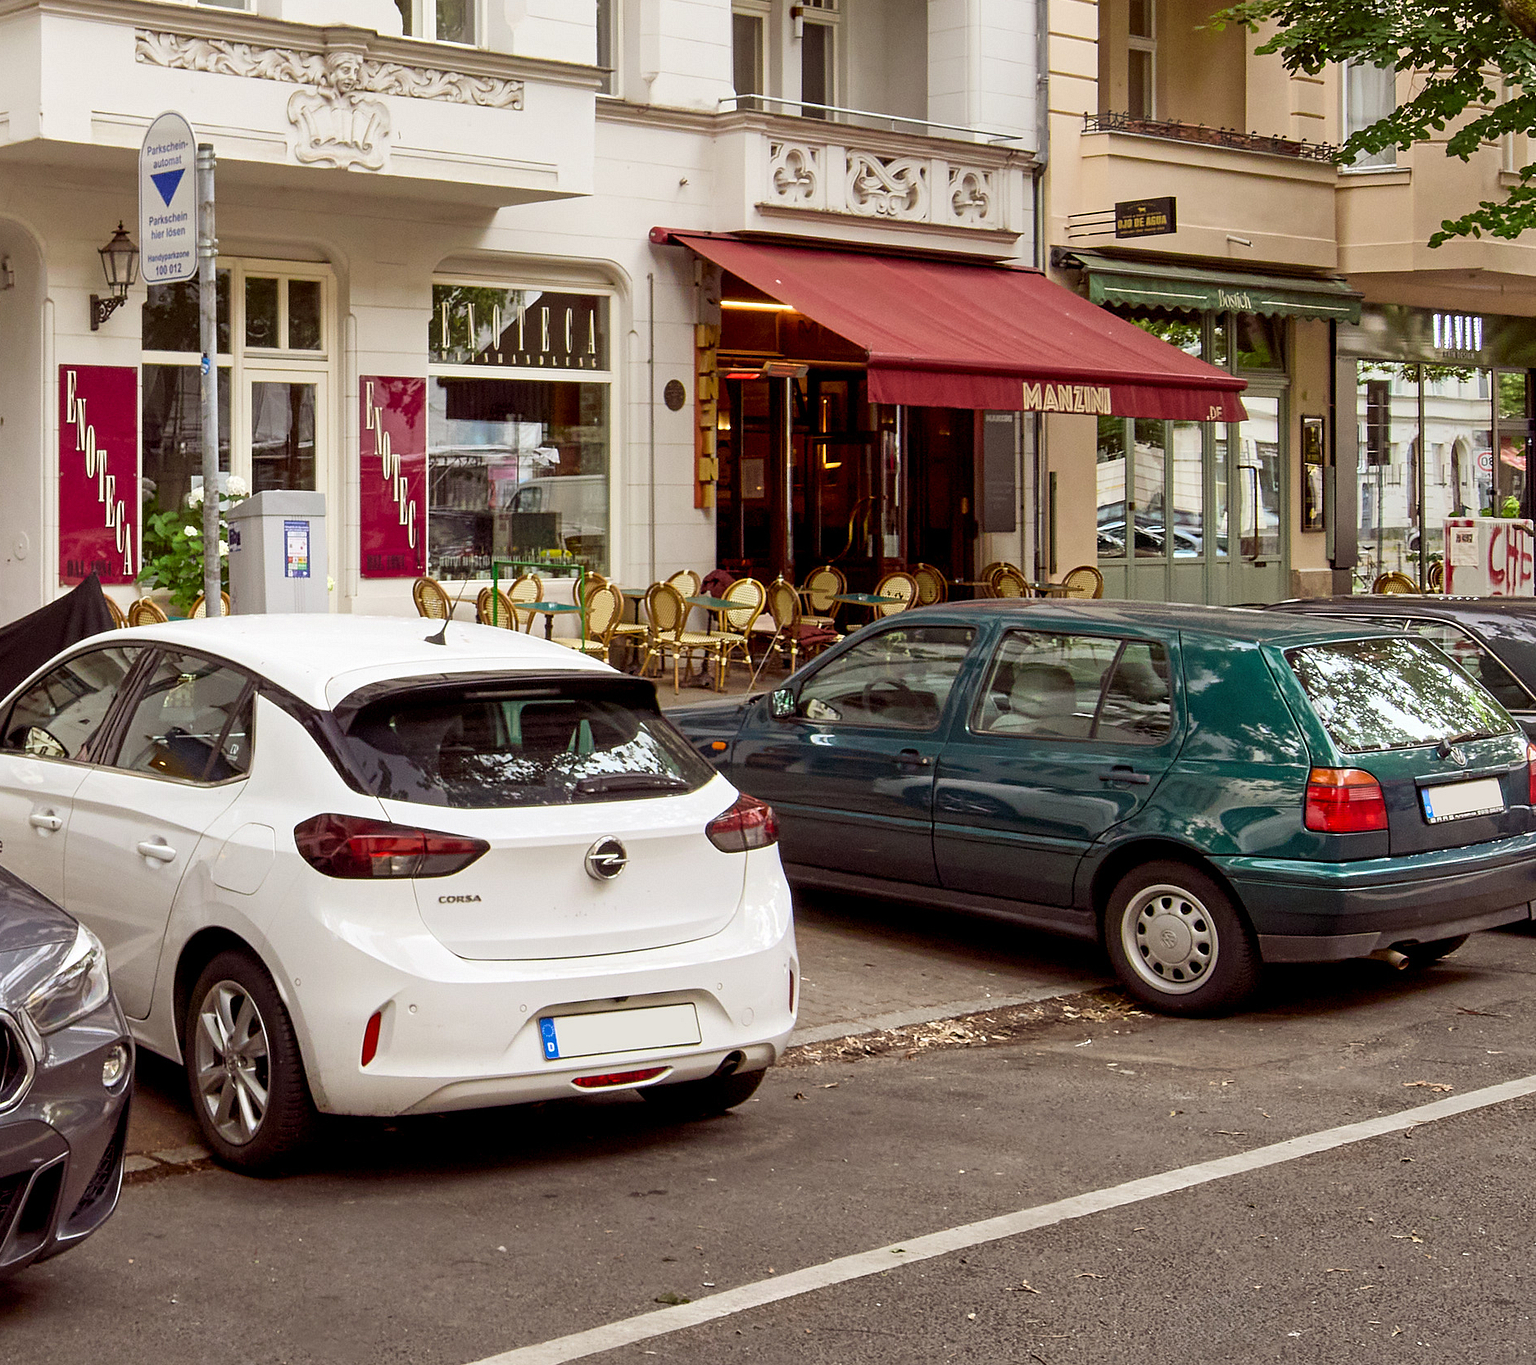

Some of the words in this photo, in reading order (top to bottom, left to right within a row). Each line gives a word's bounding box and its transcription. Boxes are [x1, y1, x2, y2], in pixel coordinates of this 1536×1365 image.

[147, 139, 188, 156] Parkschein-
[153, 155, 182, 169] automat
[149, 211, 188, 226] Parkschein
[1117, 219, 1133, 229] OJO
[1134, 217, 1145, 227] DE
[1146, 215, 1167, 226] AGUA
[151, 229, 164, 240] hier
[166, 227, 186, 238] lösen
[147, 250, 190, 263] Handyparkzone
[156, 264, 168, 276] 100
[169, 263, 182, 274] 012
[441, 301, 596, 355] ENOTECA
[1022, 381, 1112, 415] MANZINI
[66, 370, 134, 575] ENOTECA
[438, 894, 482, 904] CORSA
[547, 1041, 556, 1053] D
